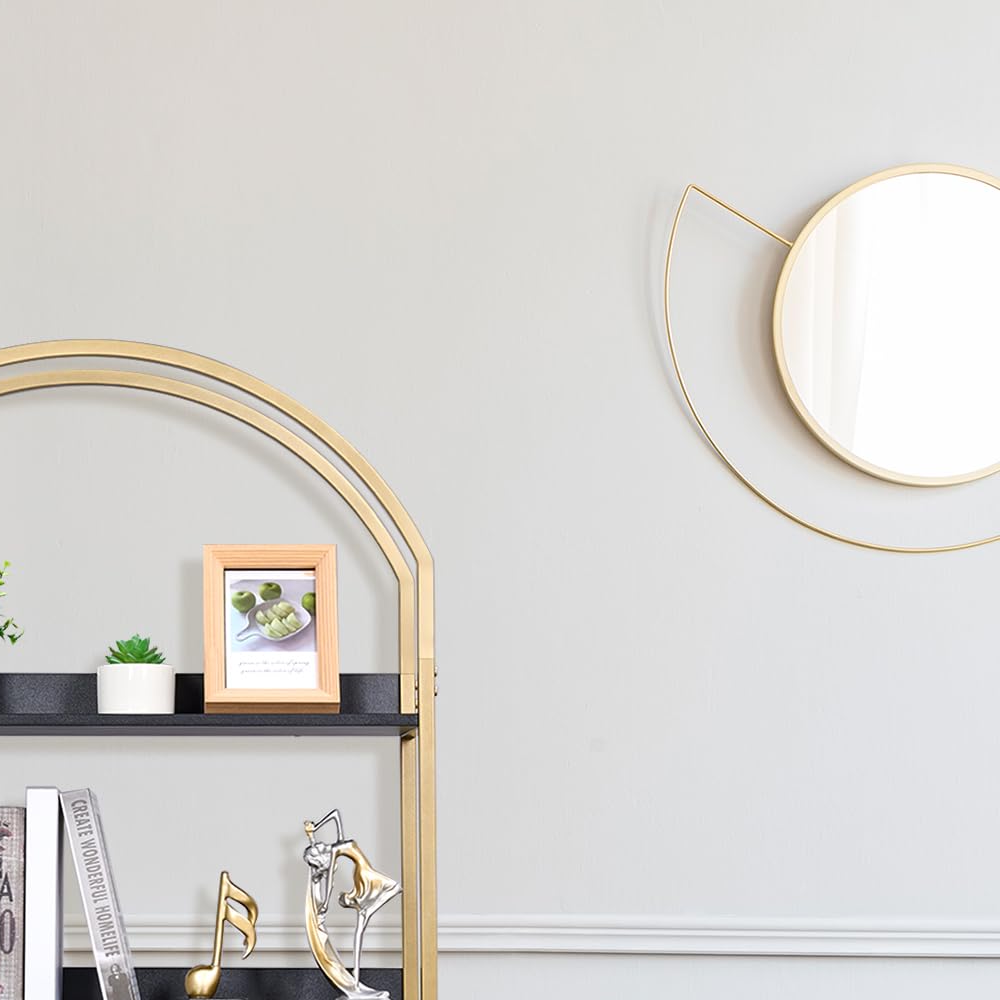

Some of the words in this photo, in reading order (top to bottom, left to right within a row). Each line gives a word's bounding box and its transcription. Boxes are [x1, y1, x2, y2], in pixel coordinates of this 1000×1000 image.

[71, 798, 93, 838] CREATE
[79, 838, 108, 904] WONDERFUL
[95, 905, 121, 958] HOMELIFE
